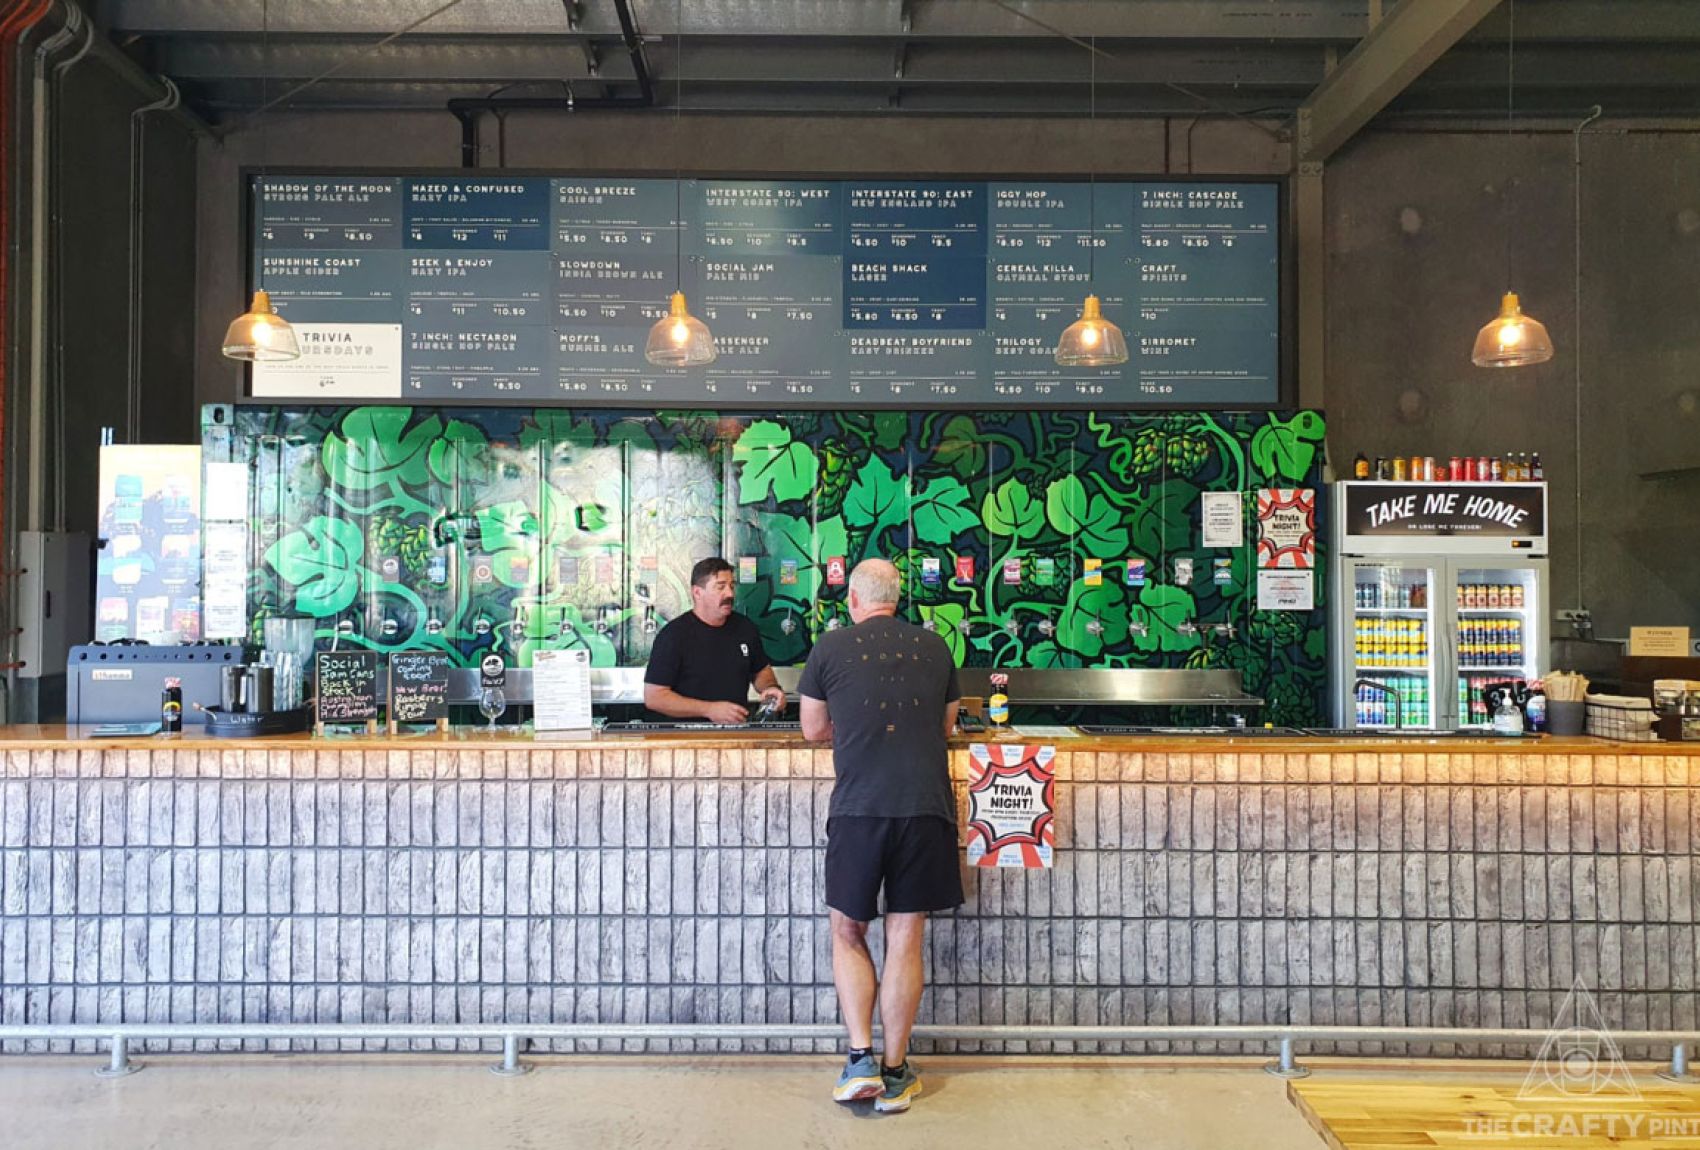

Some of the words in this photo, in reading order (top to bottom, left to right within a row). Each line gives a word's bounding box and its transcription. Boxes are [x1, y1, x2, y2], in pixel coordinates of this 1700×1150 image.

[264, 184, 308, 192] SHADOW
[412, 184, 448, 192] HAZED
[466, 185, 524, 193] CONFUSED
[560, 186, 588, 194] COOL
[594, 187, 636, 195] BREEZE
[706, 189, 772, 197] INTERSTATE
[801, 190, 830, 198] WEST
[922, 190, 940, 198] 90:
[946, 190, 973, 198] EAST
[264, 258, 319, 266] SUNSHINE
[706, 264, 746, 272] SOCIAL
[303, 332, 352, 342] TRIVIA
[713, 337, 769, 346] ASSENGER
[302, 345, 374, 354] URSDAYS
[714, 346, 734, 354] ALE
[1366, 495, 1416, 528] TAKE
[1424, 494, 1460, 514] ME
[1463, 496, 1529, 528] HOME
[320, 654, 365, 669] Social
[392, 654, 425, 666] Ginger
[320, 669, 346, 678] Jam
[993, 784, 1032, 796] TRIVIA
[990, 798, 1034, 809] NIGHT!
